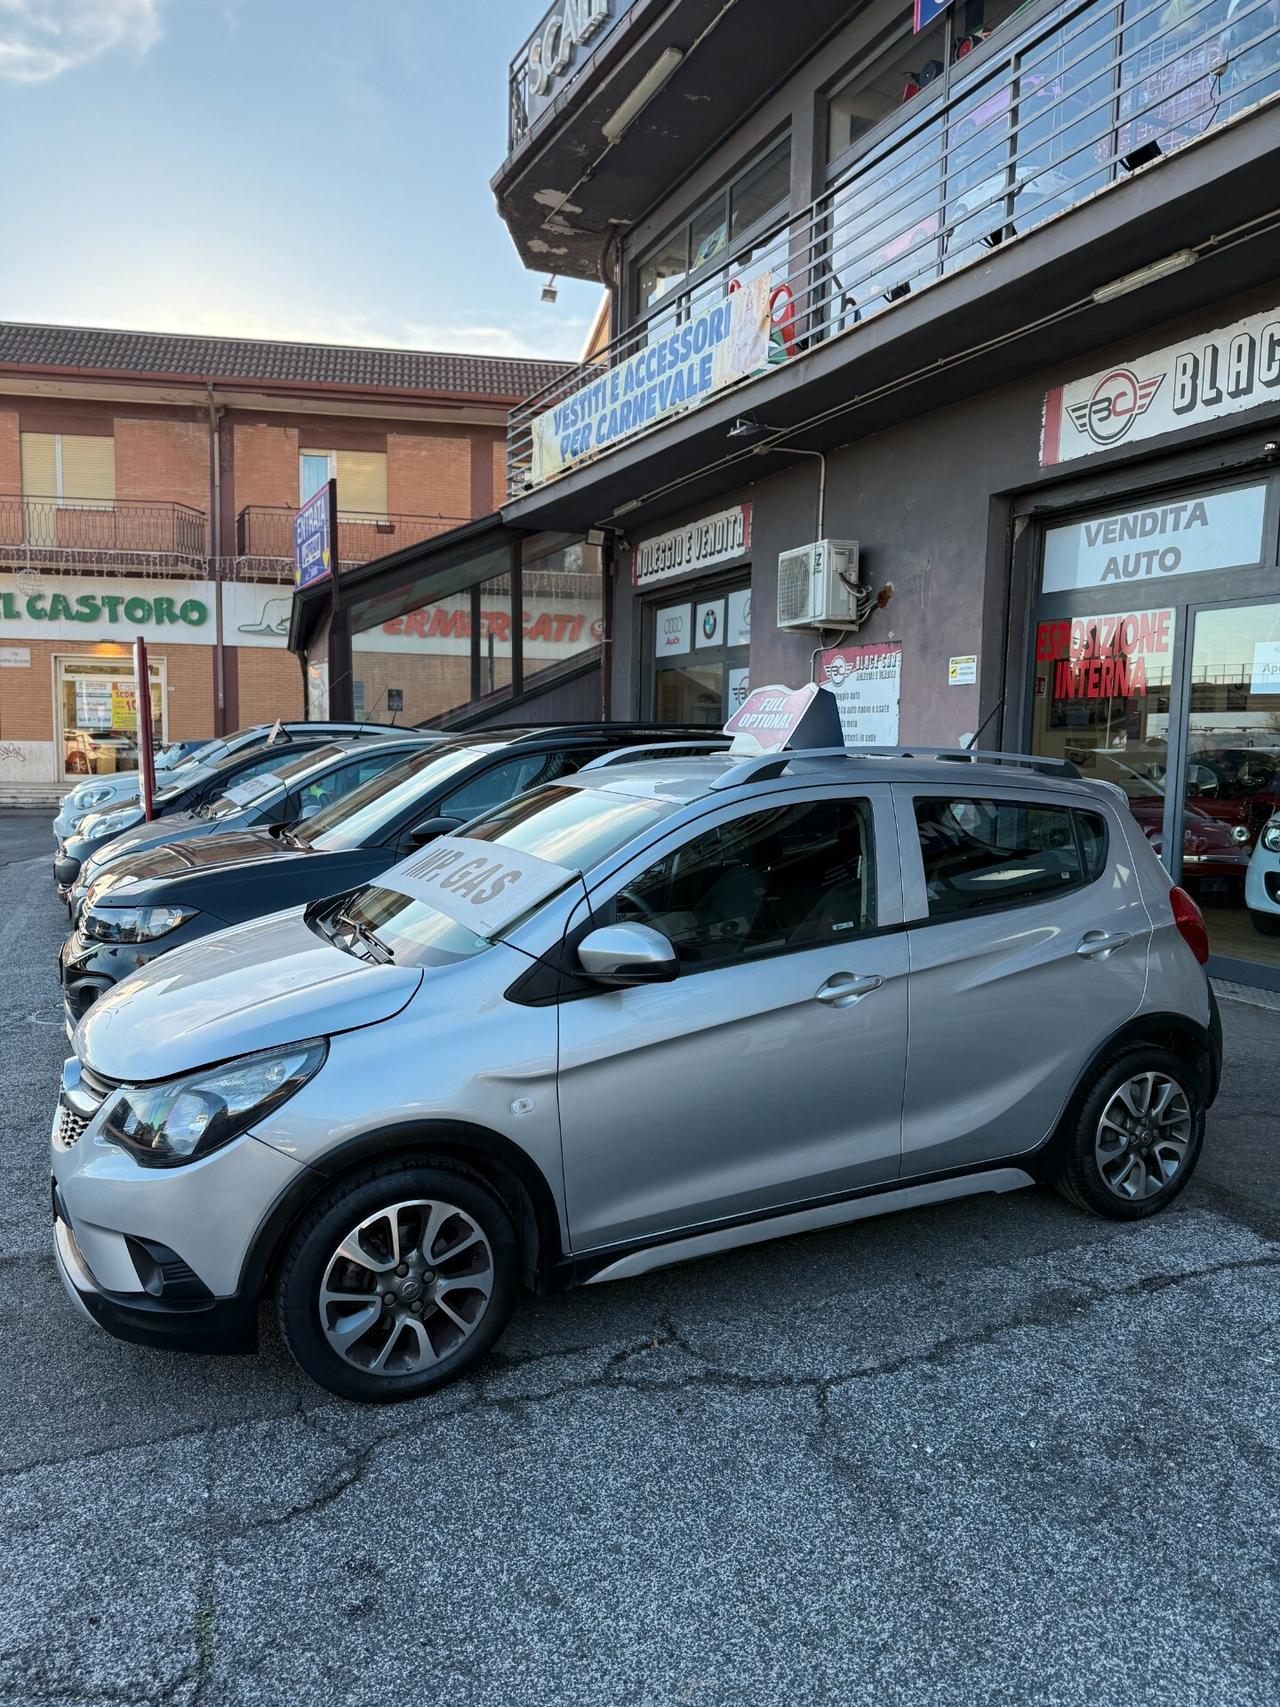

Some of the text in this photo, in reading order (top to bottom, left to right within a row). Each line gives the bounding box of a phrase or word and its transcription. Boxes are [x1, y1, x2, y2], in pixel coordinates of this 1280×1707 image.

[553, 302, 732, 436] VESTITI E ACCESSORI
[560, 352, 713, 464] PER CARNEVALE
[637, 511, 744, 578] NOLEGGIO E VENDITA
[1084, 501, 1210, 547] VENDITA
[1099, 546, 1182, 582] AUTO
[26, 592, 208, 627] CASTORO
[1036, 611, 1171, 663] ESPOSIZIONE
[1055, 656, 1146, 699] INTERNA
[1262, 663, 1280, 676] Ap
[738, 713, 794, 729] OPTIONAL
[758, 697, 788, 712] FULL
[440, 857, 523, 905] GAS
